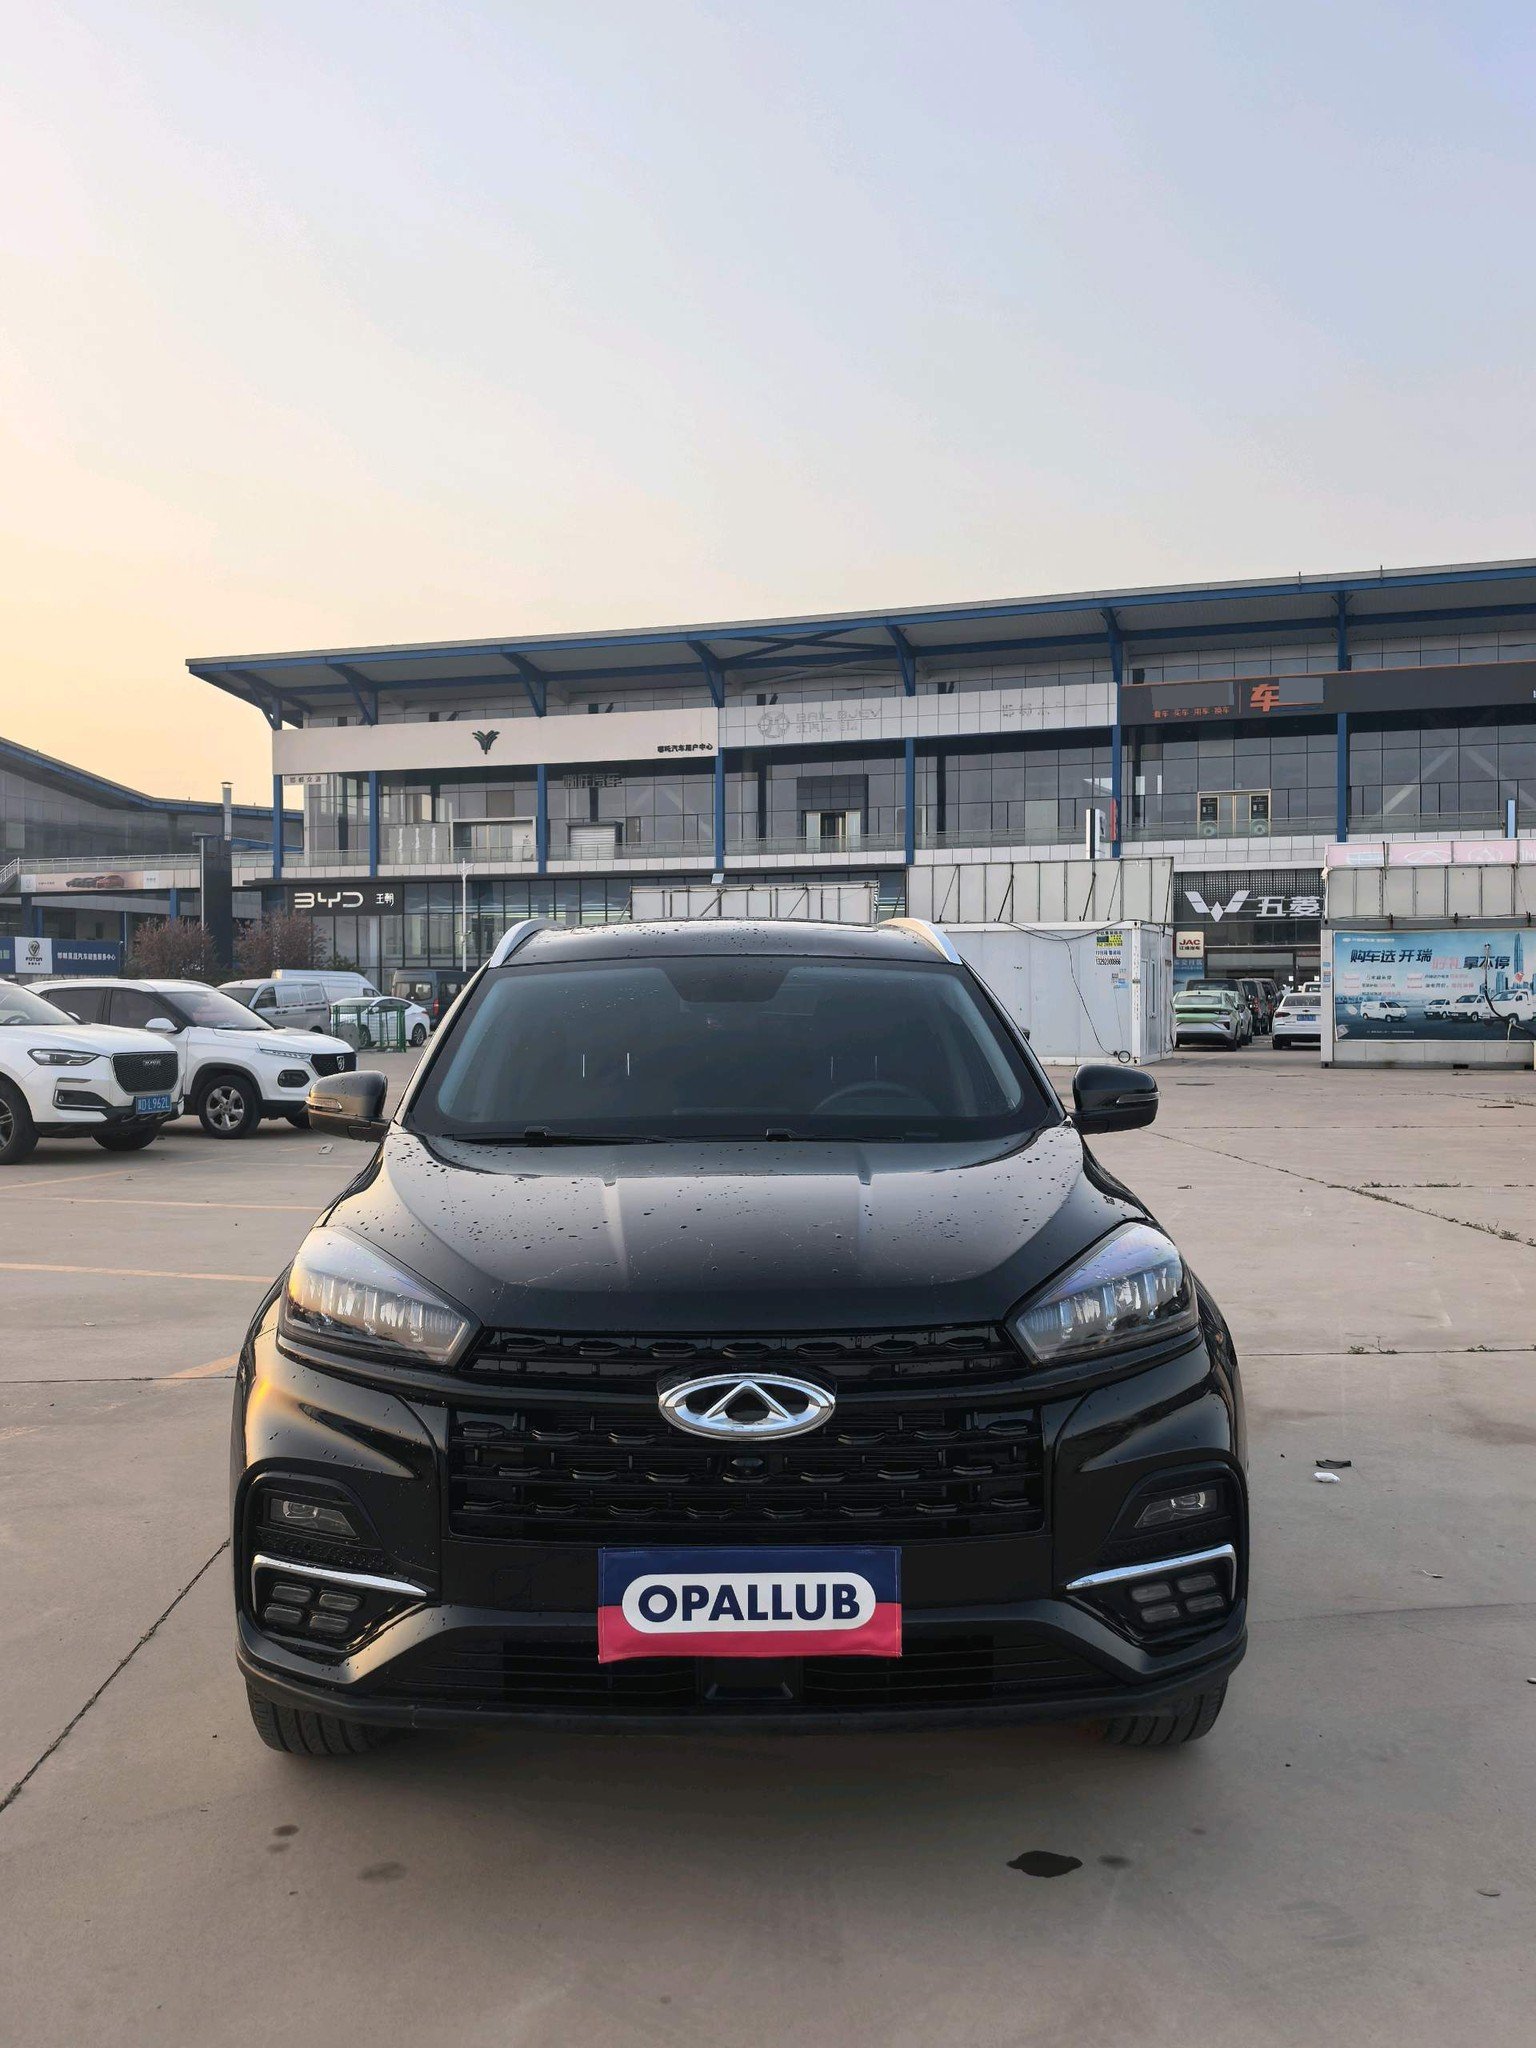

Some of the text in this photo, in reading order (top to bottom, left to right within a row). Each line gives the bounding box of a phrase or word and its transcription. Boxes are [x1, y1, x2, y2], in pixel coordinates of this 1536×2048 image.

[294, 892, 364, 909] BYD
[375, 893, 395, 907] 王朝
[1256, 896, 1320, 918] 五菱
[638, 1583, 860, 1623] OPALLUB
